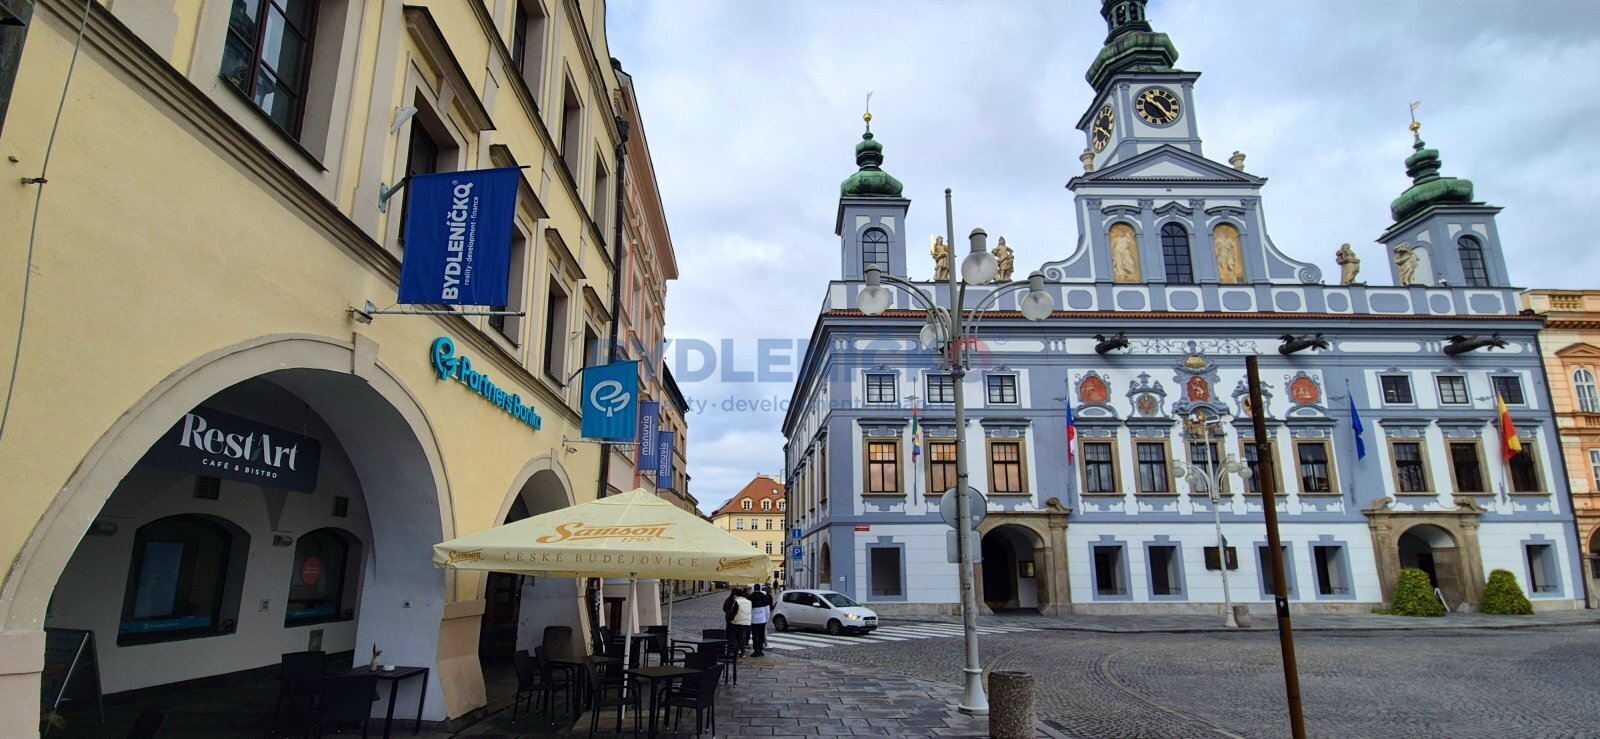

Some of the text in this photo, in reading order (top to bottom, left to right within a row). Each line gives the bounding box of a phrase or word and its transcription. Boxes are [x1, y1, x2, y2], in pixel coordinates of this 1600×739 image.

[464, 196, 479, 286] reality development finance
[458, 356, 542, 431] Partners Banka
[179, 412, 299, 471] RestArt
[640, 415, 650, 456] manuvia
[202, 457, 229, 470] CAFÉ
[244, 466, 278, 479] BISTRO
[659, 442, 667, 477] manuvia
[536, 522, 675, 544] Samson
[444, 548, 485, 568] Samson
[503, 551, 563, 562] ČESKÉ
[716, 556, 754, 572] Samson
